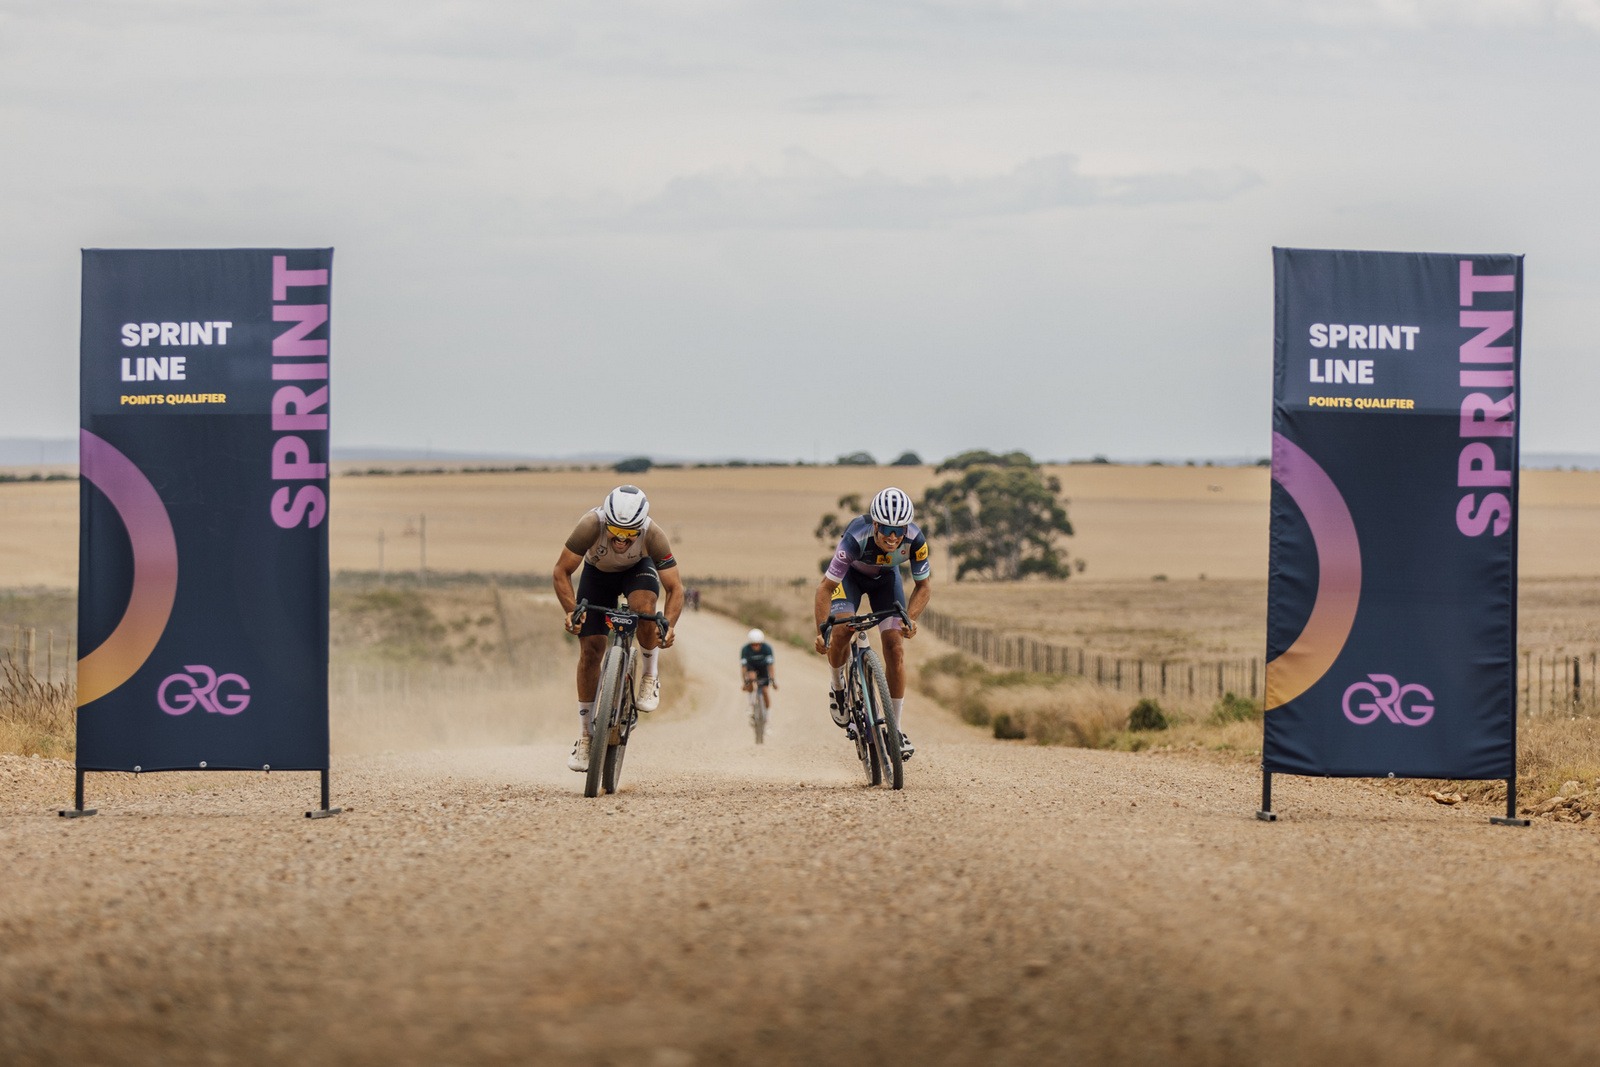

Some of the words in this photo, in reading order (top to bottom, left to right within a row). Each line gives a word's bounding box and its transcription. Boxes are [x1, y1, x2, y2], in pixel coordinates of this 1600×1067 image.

[121, 321, 233, 347] SPRINT
[1308, 322, 1421, 351] SPRINT
[121, 356, 187, 382] LINE
[1308, 358, 1375, 385] LINE
[120, 394, 164, 406] POINTS
[165, 393, 227, 405] QUALIFIER
[271, 255, 329, 529] SPRINT
[1308, 396, 1353, 409] POINTS
[1353, 397, 1415, 410] QUALIFIER
[1456, 260, 1515, 537] SPRINT
[157, 665, 251, 716] GRG
[1342, 673, 1435, 727] GRG
